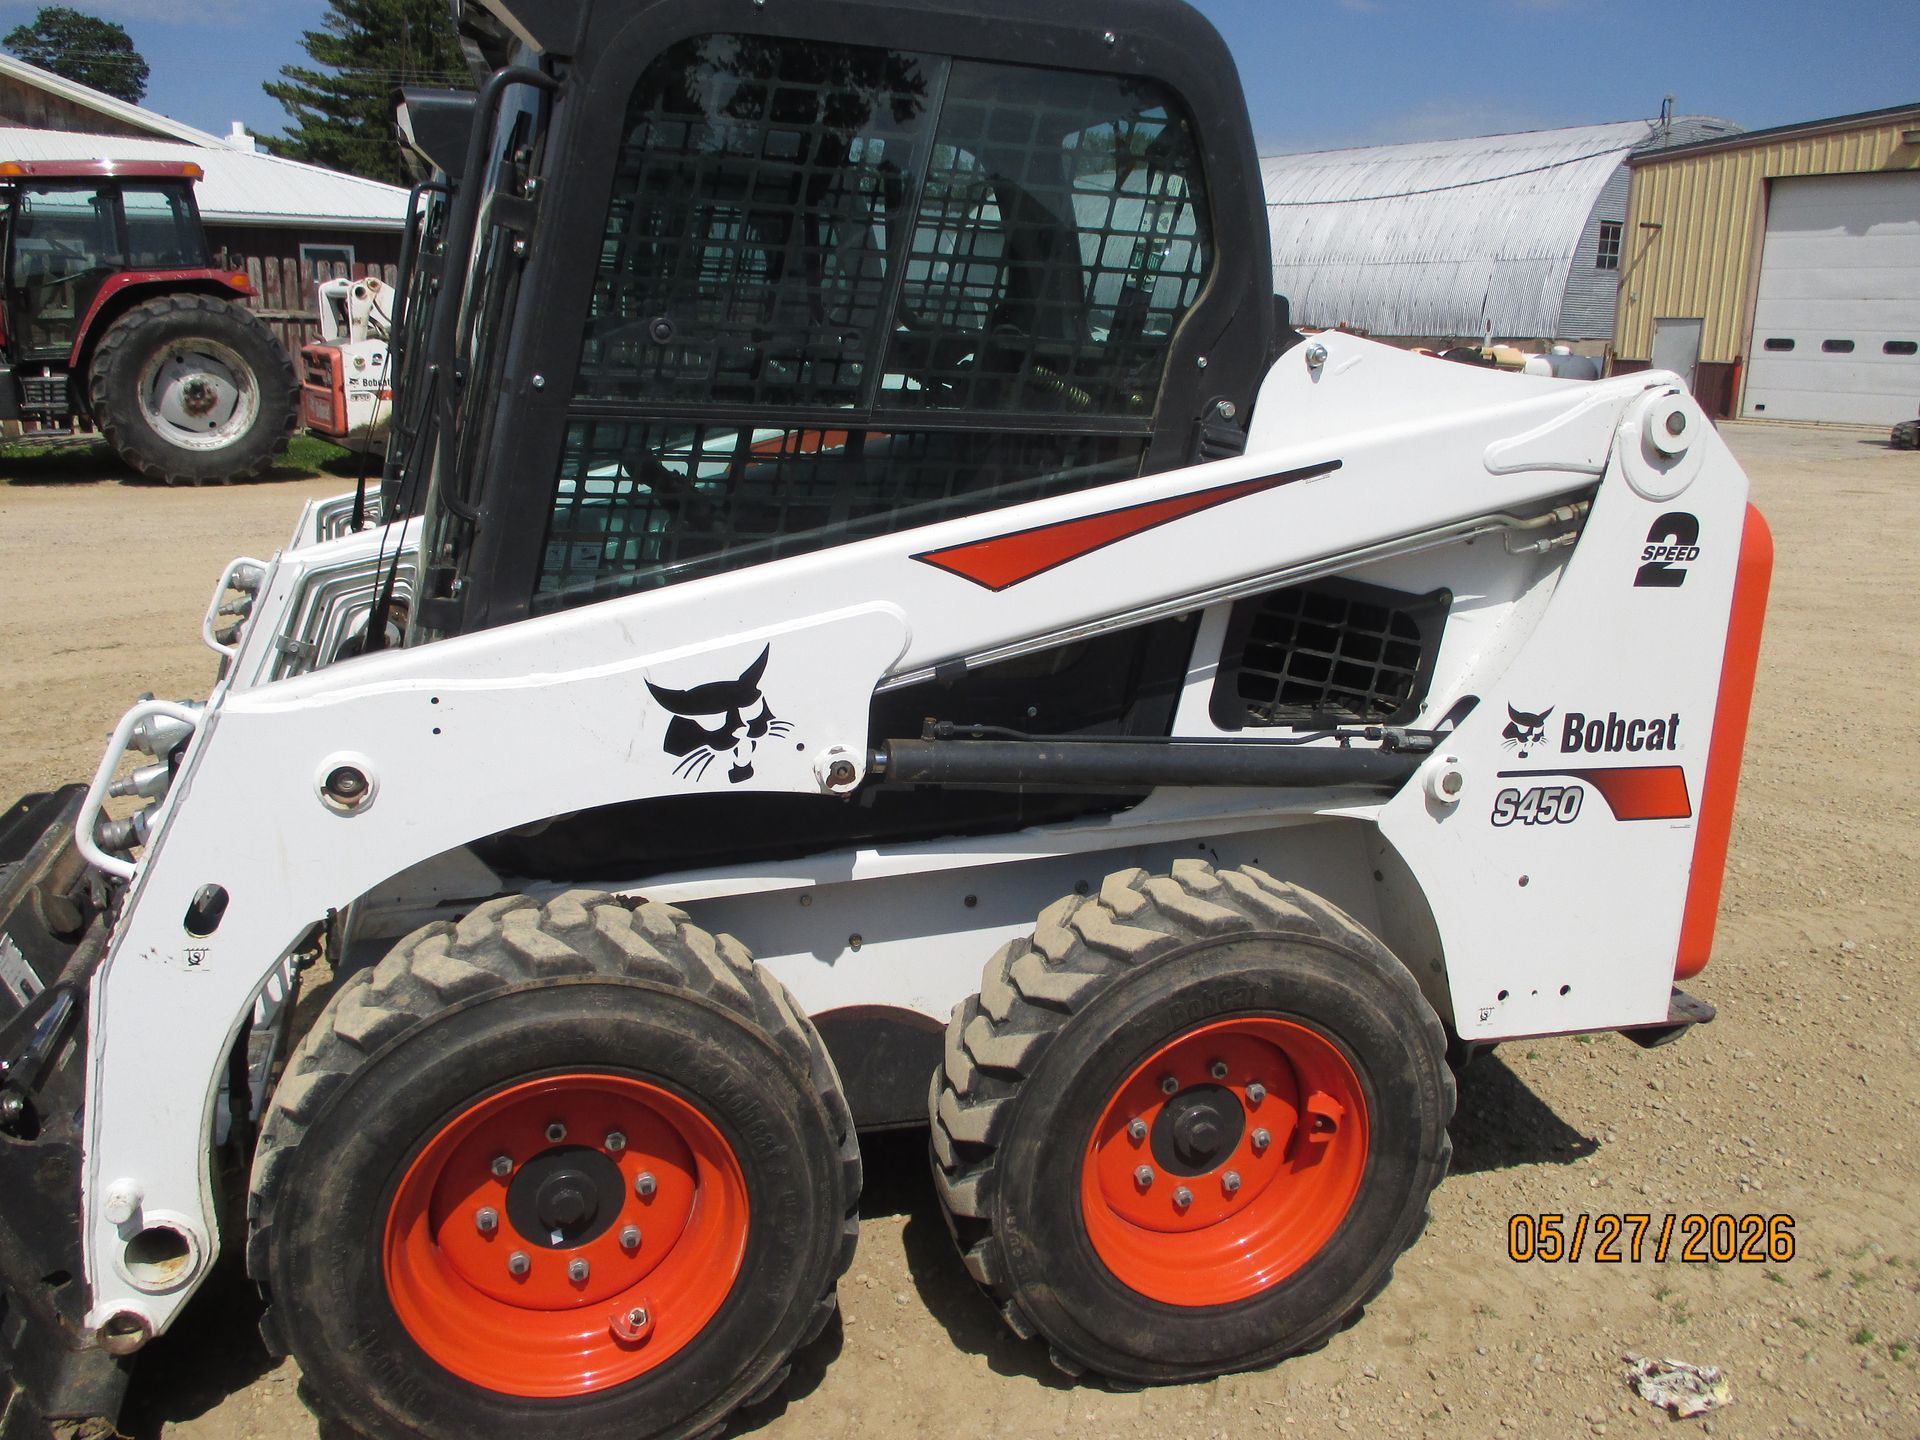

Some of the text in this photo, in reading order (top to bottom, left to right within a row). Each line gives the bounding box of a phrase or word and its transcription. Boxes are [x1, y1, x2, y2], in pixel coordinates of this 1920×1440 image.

[1633, 511, 1700, 587] 2
[1641, 545, 1700, 561] SPEED
[1561, 712, 1681, 753] Bobcat
[1491, 786, 1584, 827] S450
